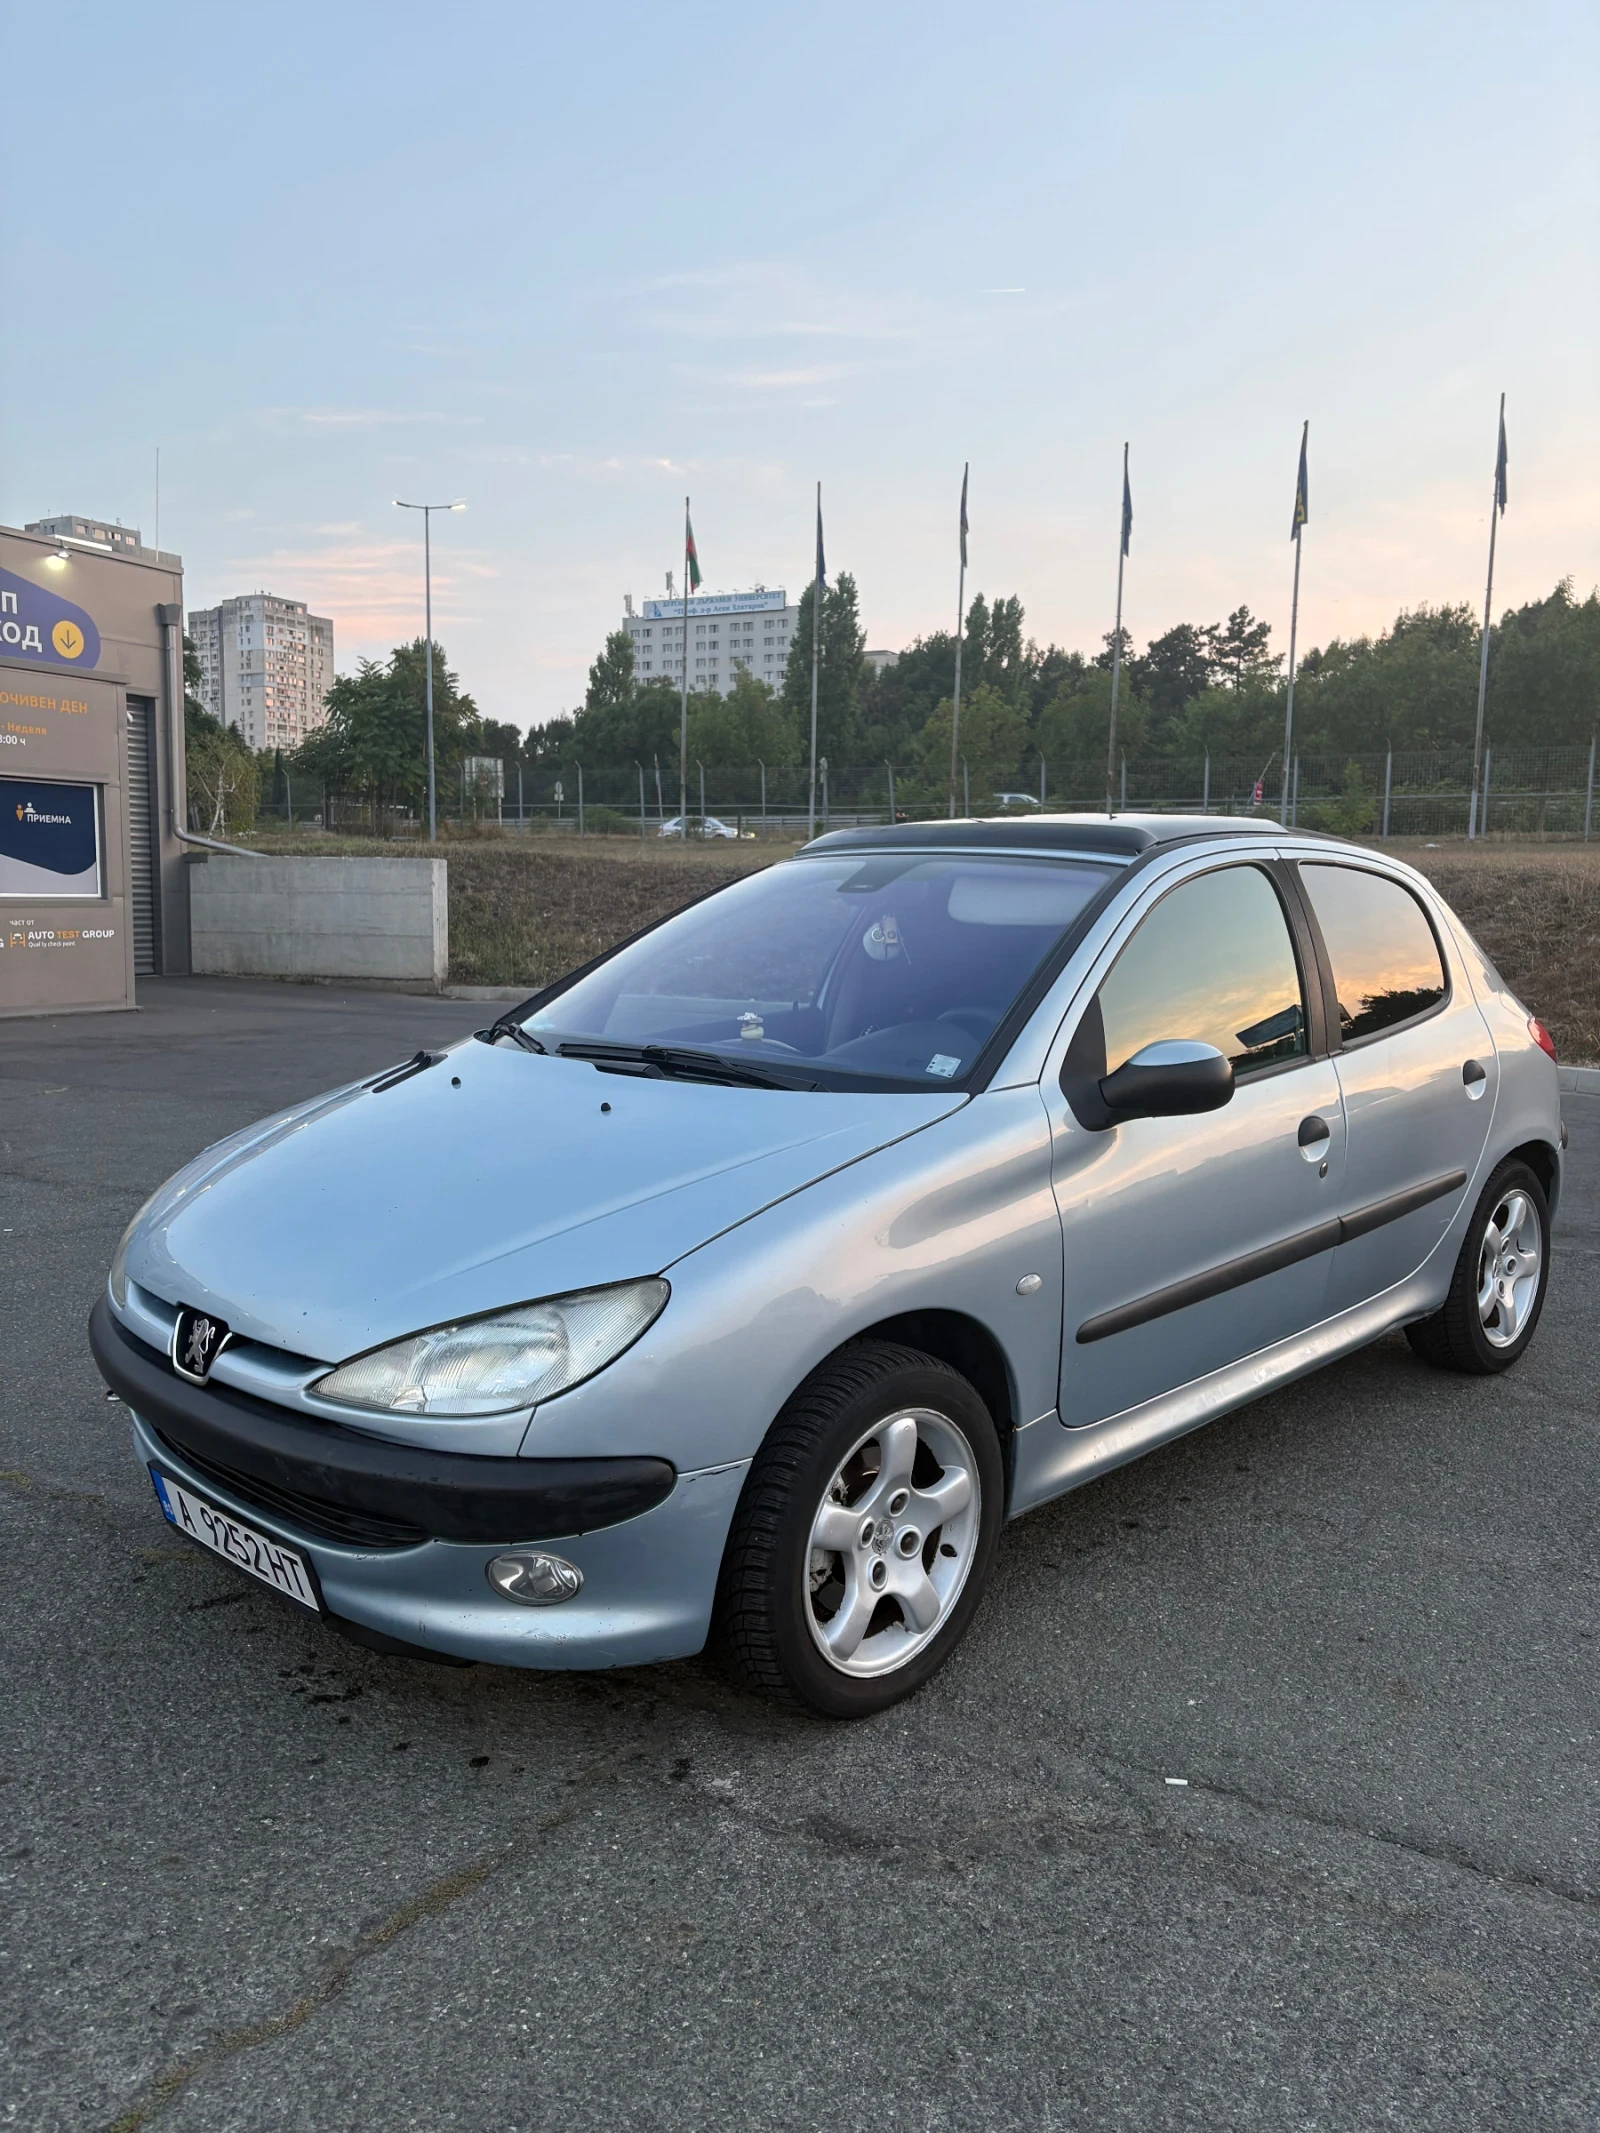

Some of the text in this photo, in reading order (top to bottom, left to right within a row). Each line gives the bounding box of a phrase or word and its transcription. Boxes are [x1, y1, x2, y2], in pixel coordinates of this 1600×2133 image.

[1, 591, 18, 615] П
[0, 621, 43, 653] ОД
[0, 691, 88, 714] ОЧИВЕН ДЕН
[7, 721, 47, 735] Неделя
[26, 813, 72, 824] ПРИЕМНА
[28, 929, 115, 940] AUTO TEST GROUP
[177, 1490, 198, 1534] A
